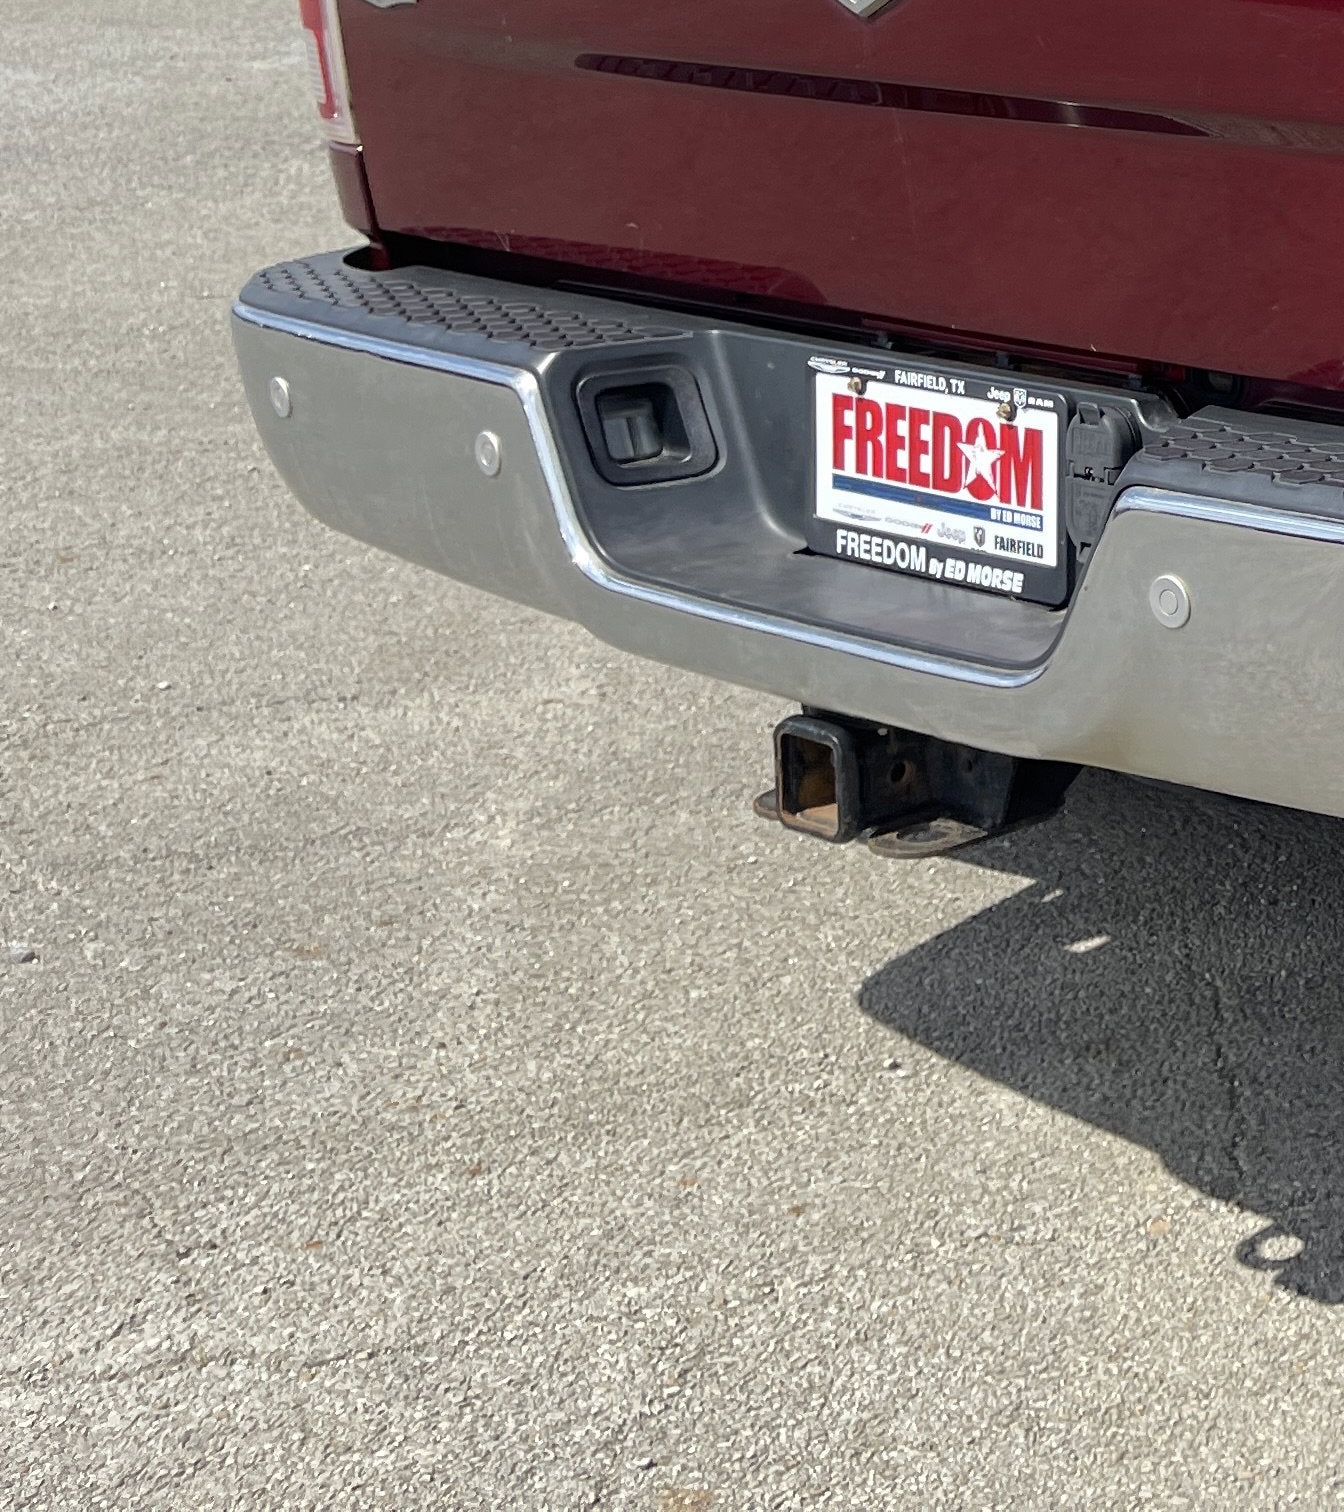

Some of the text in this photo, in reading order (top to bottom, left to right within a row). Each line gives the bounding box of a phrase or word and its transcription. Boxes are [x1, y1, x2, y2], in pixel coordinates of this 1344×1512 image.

[894, 370, 947, 396] FAIRFIELD,
[950, 379, 966, 395] TX
[986, 387, 1011, 404] Jeep
[831, 392, 1044, 512] FREEDOM
[1013, 511, 1042, 530] MORSE
[836, 529, 926, 572] FREEDOM
[944, 558, 966, 581] ED
[967, 563, 1025, 594] MORSE
[994, 534, 1044, 559] FAIRFIELD
